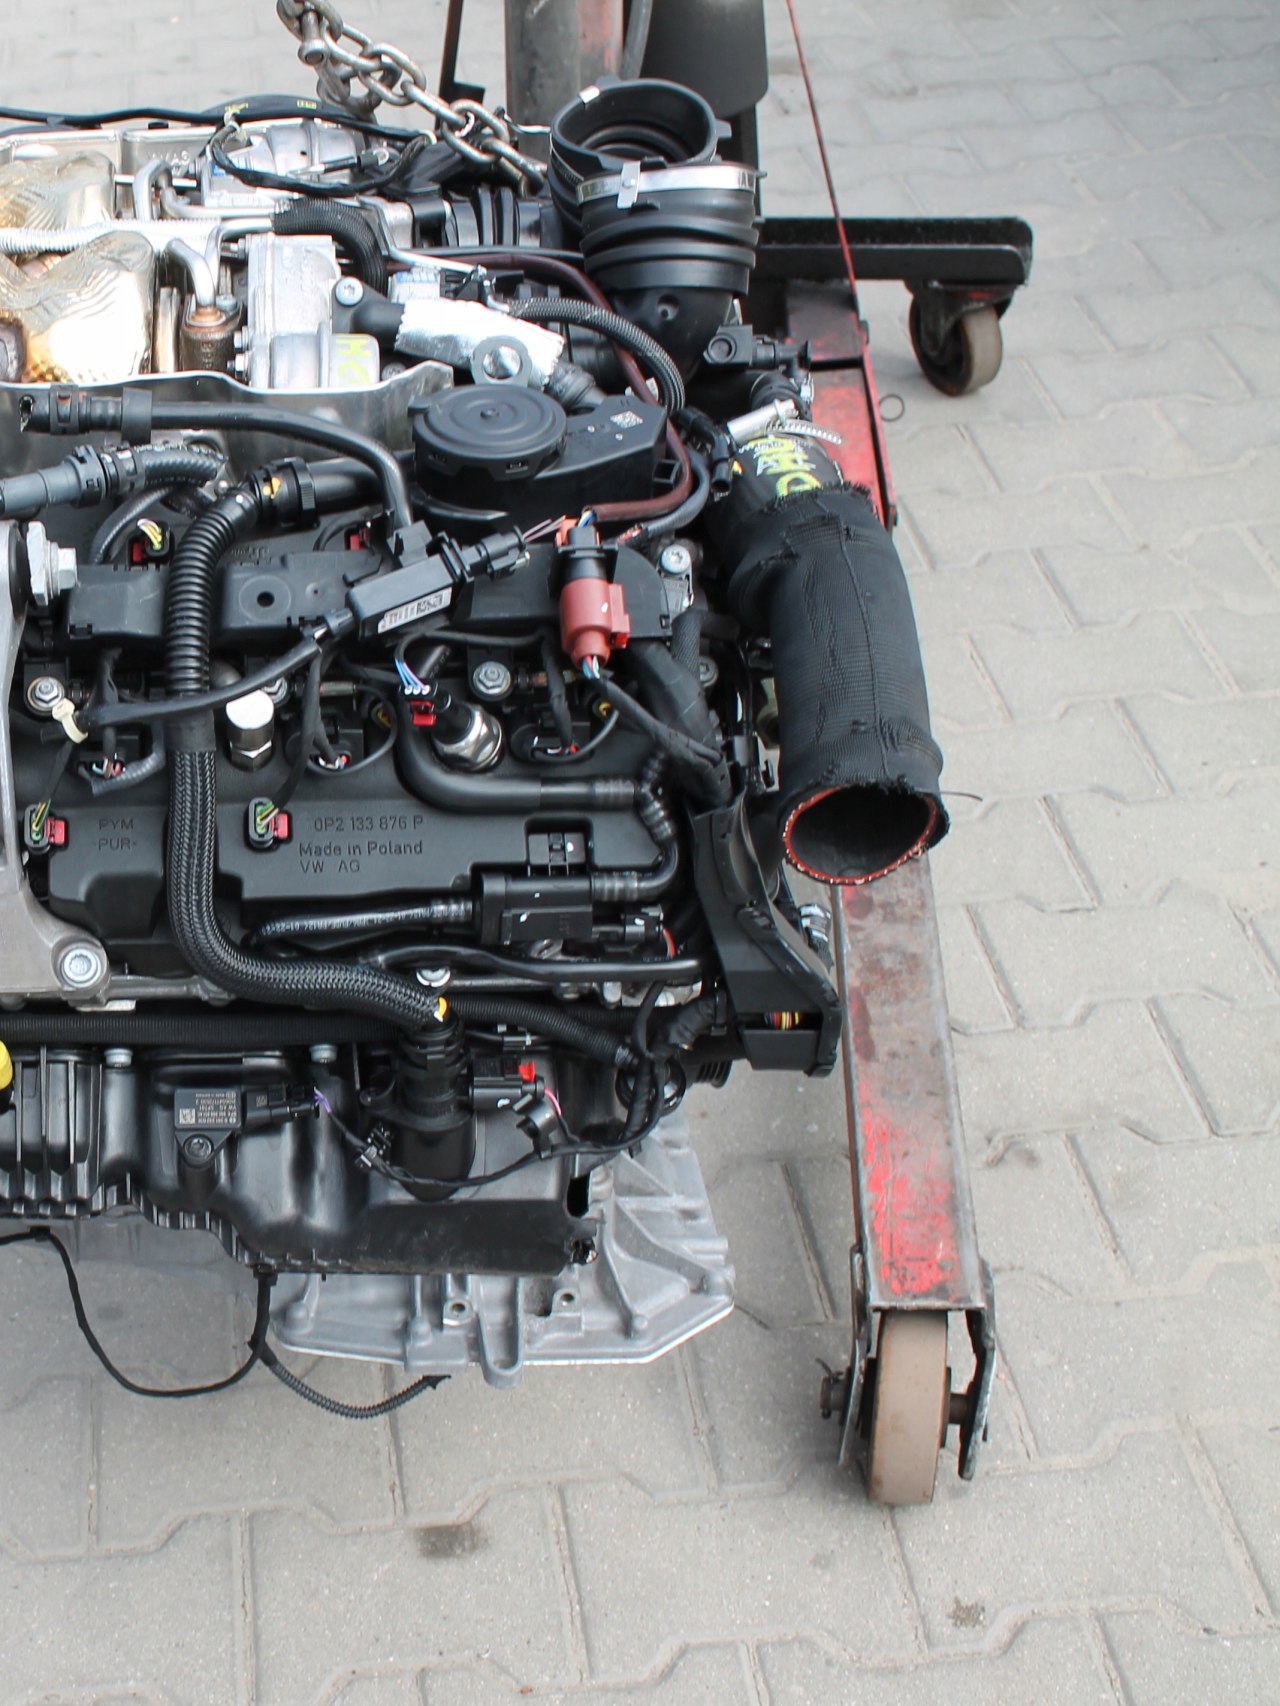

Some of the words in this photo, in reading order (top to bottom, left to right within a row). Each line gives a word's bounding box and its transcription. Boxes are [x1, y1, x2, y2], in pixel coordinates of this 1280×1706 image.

[98, 818, 134, 830] PYM
[350, 815, 374, 831] 133
[379, 815, 407, 831] 876
[413, 814, 424, 830] P
[299, 841, 342, 857] Made
[347, 841, 362, 856] in
[367, 840, 423, 856] Poland
[300, 860, 325, 874] VW
[338, 859, 361, 873] AG
